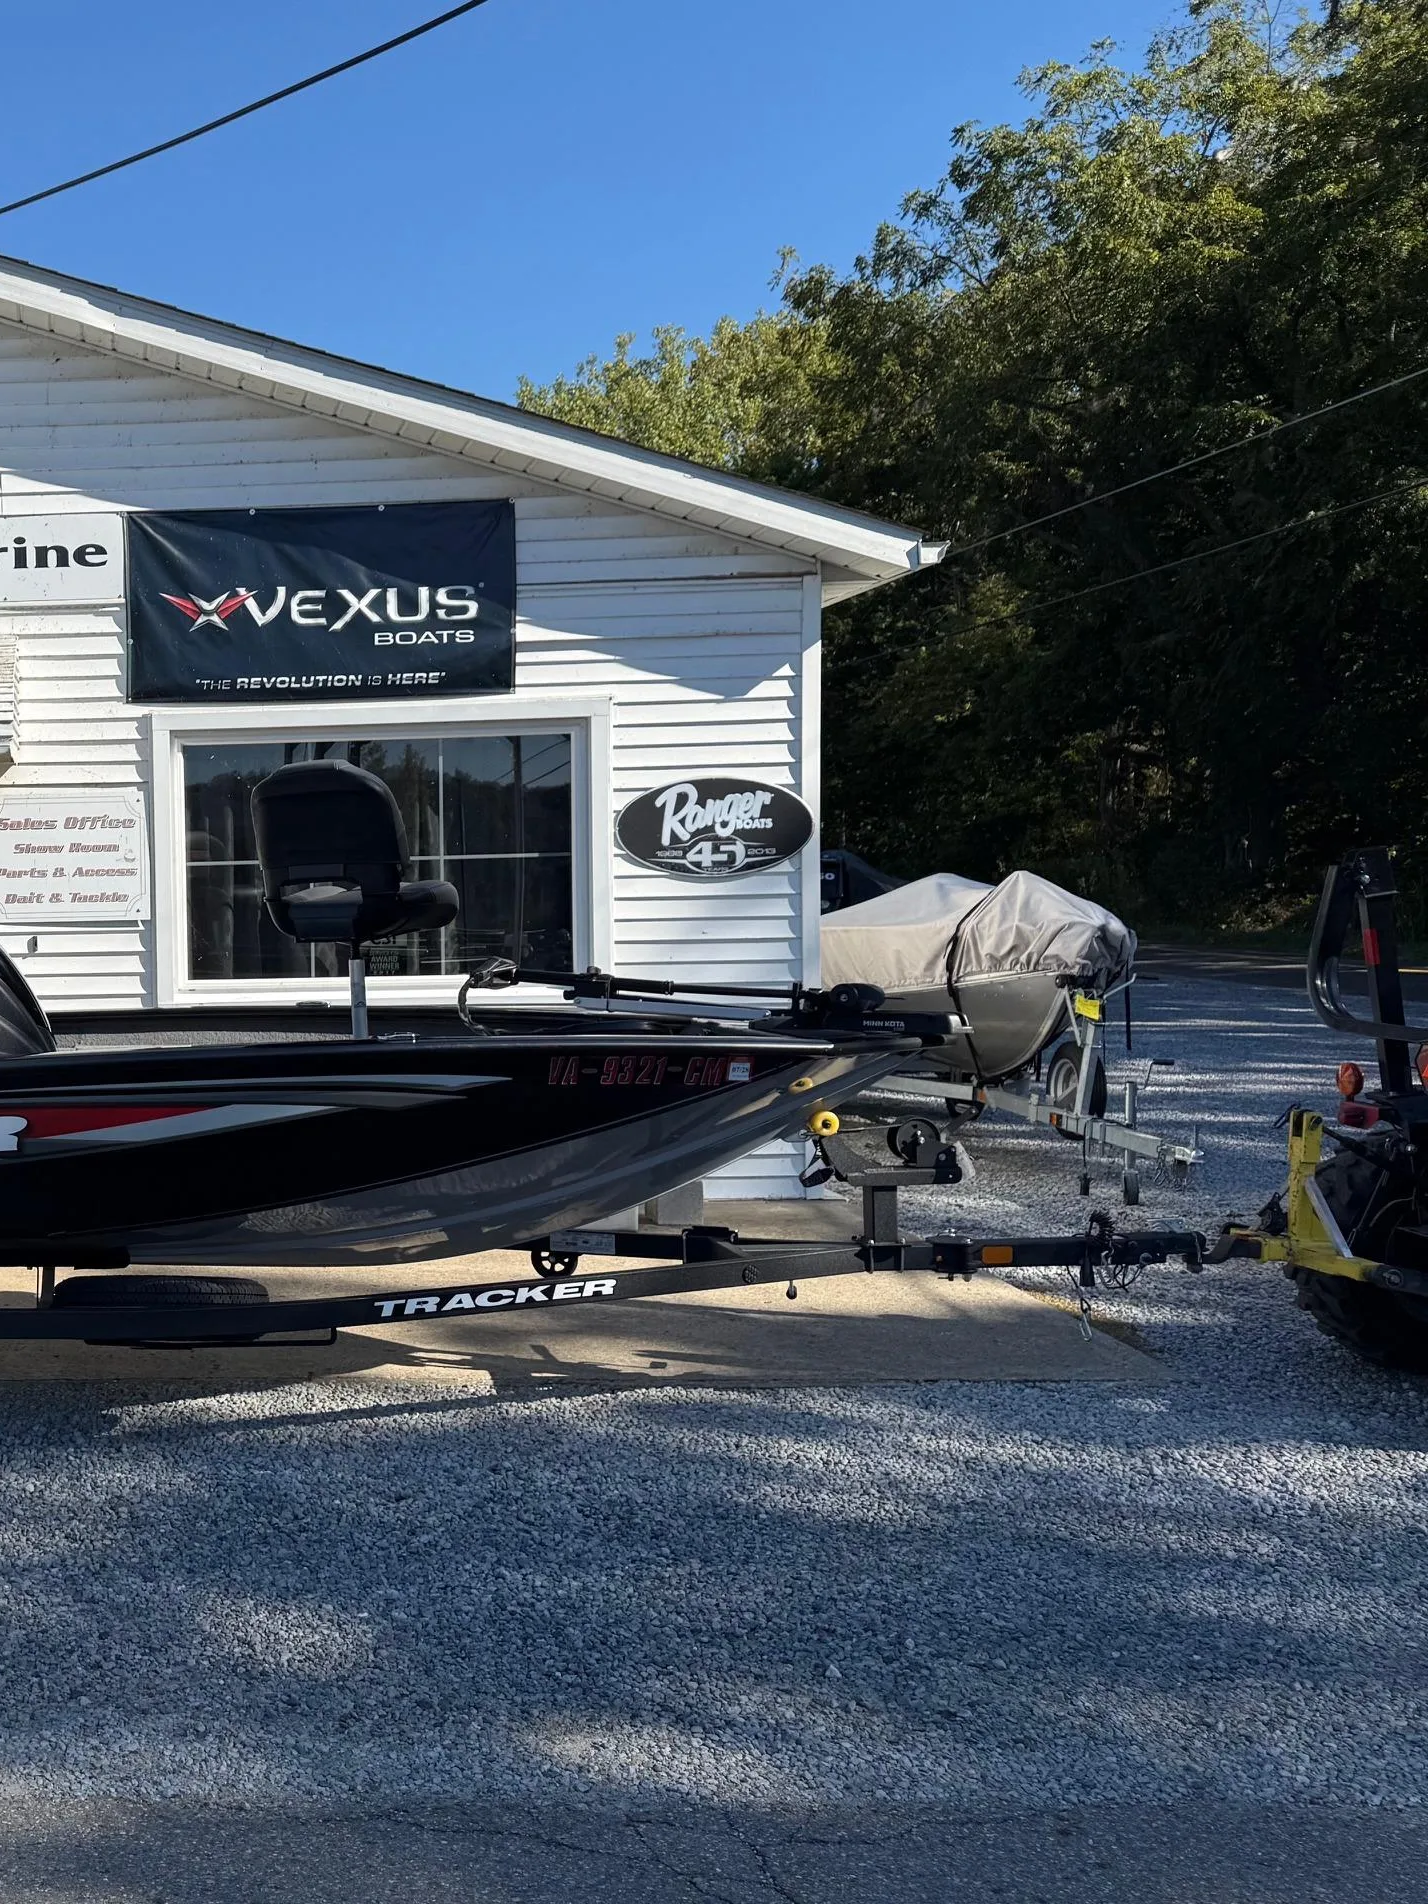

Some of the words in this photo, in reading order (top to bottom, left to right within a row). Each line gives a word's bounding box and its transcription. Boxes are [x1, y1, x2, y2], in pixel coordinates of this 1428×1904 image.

[236, 586, 478, 632] VEXUS
[374, 629, 476, 646] BOATS
[236, 674, 362, 689] REVOLUTION
[367, 675, 382, 686] IS
[63, 814, 135, 830] Office
[655, 782, 774, 847] Ranger
[735, 817, 773, 830] BOATS
[13, 843, 64, 854] Show
[69, 842, 119, 853] Room
[52, 867, 67, 878] &
[72, 867, 138, 878] Access
[4, 892, 45, 904] Bait
[49, 892, 65, 903] &
[69, 891, 130, 903] Tackle
[373, 1278, 617, 1317] TRACKER
